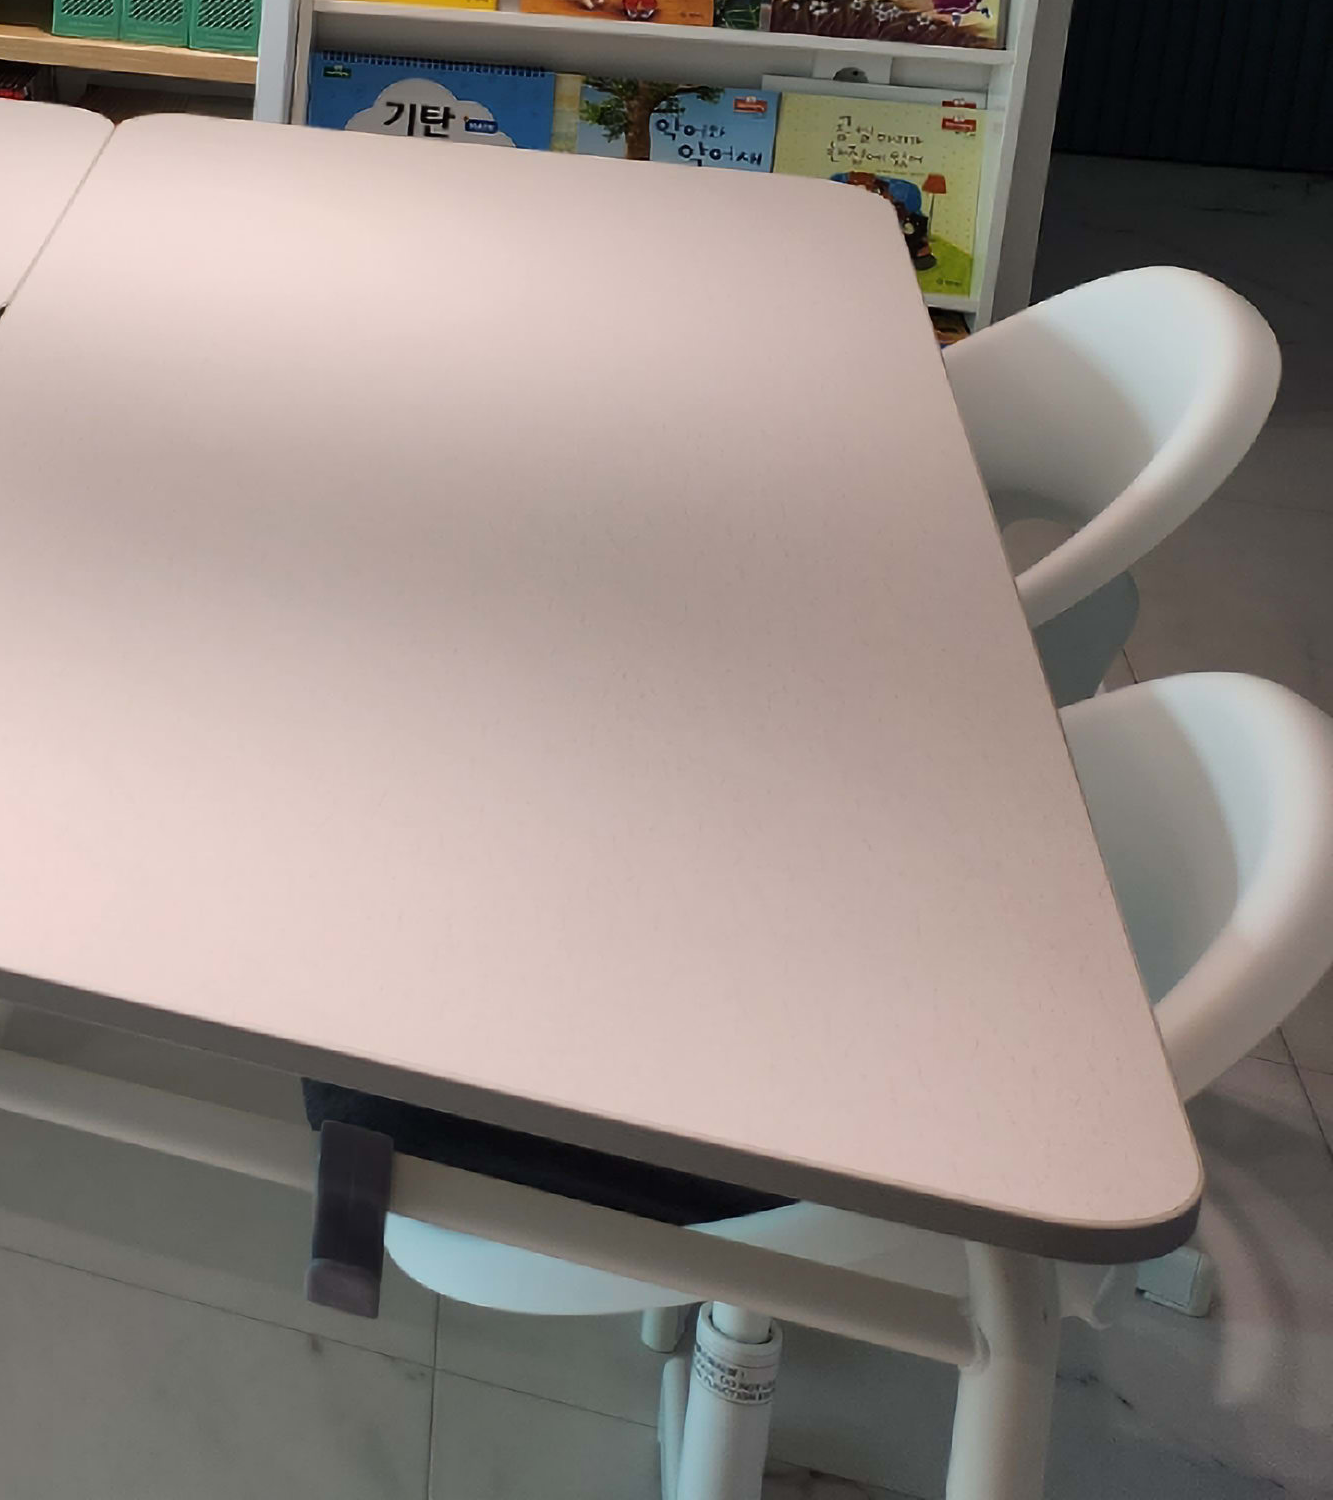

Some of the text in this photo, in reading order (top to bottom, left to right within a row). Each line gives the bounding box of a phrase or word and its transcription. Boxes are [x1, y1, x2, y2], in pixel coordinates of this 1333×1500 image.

[383, 101, 456, 138] 기탄
[655, 116, 726, 141] 악어와
[677, 141, 763, 167] 악어새
